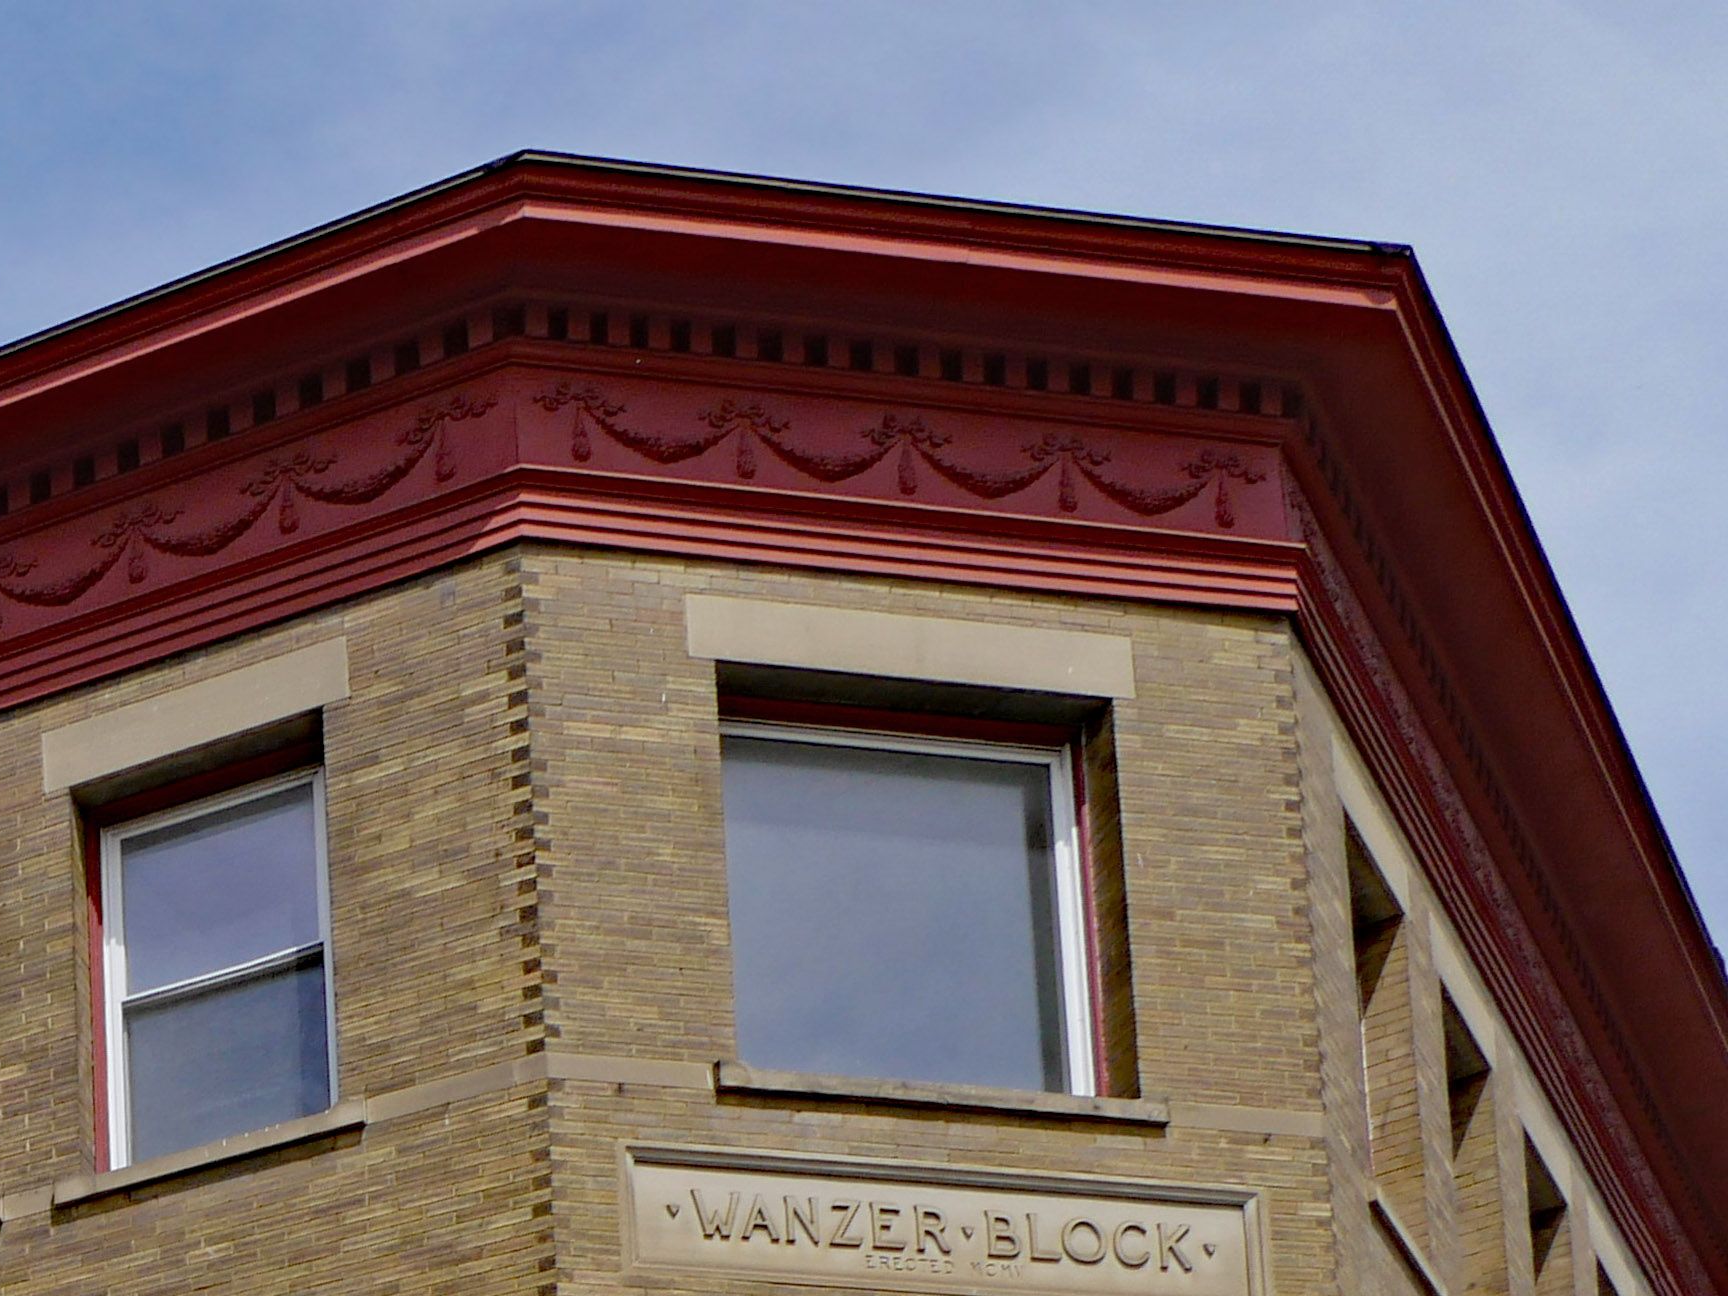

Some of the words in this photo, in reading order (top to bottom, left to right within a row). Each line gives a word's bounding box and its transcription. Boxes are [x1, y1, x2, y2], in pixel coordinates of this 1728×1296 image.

[690, 1187, 952, 1256] WANZER
[982, 1208, 1194, 1273] BLOCK
[864, 1253, 956, 1275] ERECTED
